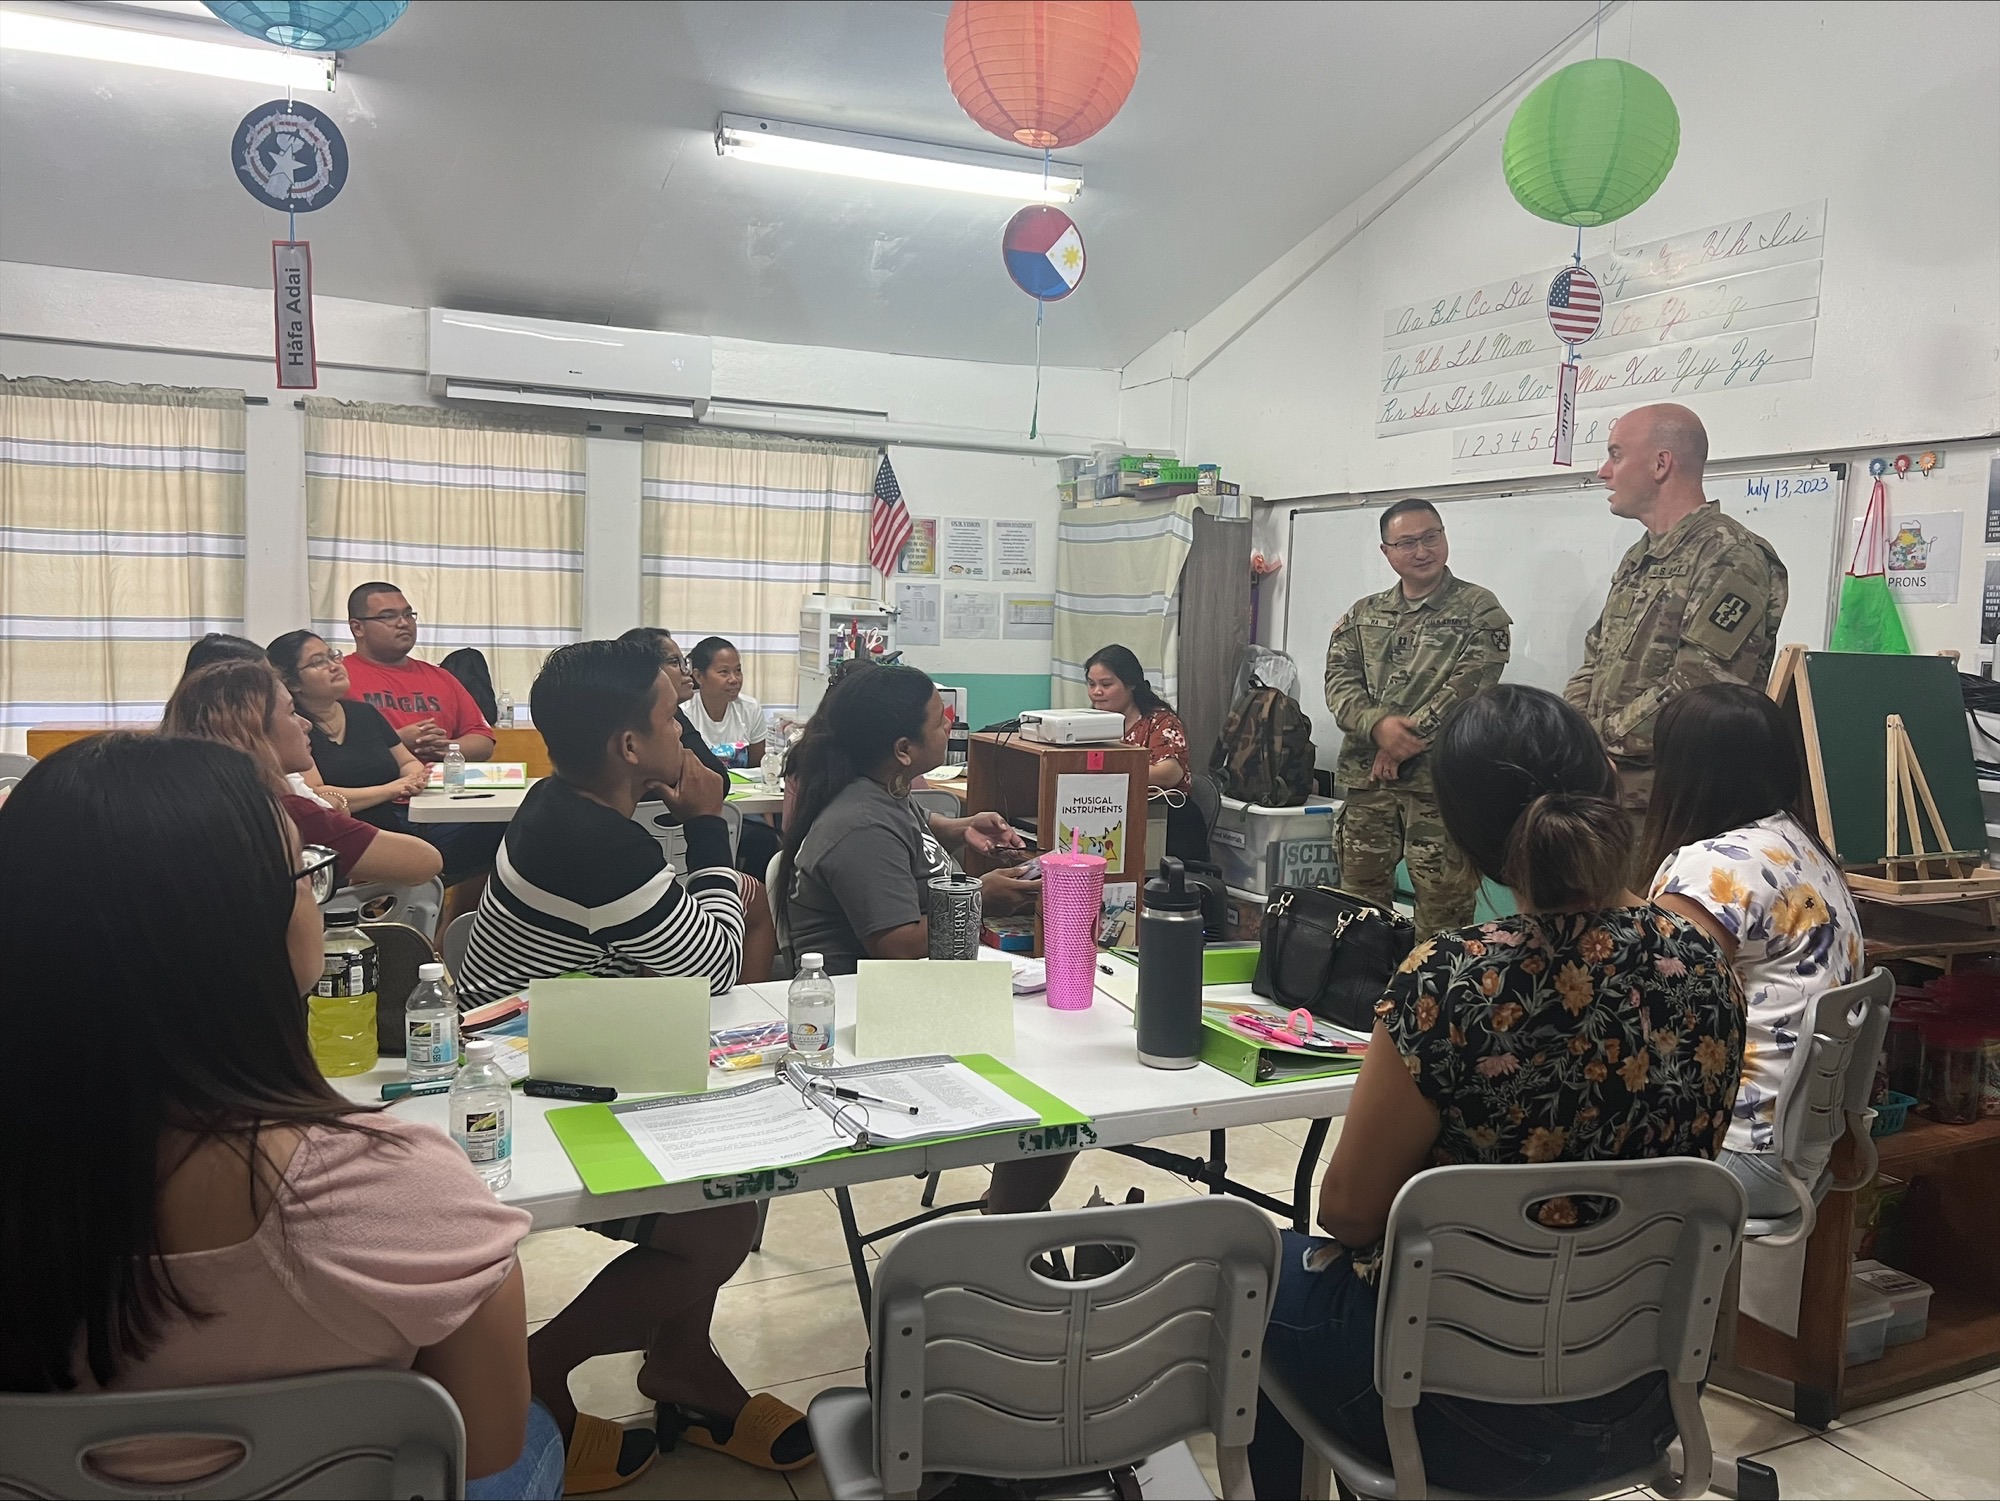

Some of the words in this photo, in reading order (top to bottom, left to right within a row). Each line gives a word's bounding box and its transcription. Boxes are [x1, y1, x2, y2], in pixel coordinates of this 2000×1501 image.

[285, 267, 302, 314] Adai
[1396, 307, 1423, 335] Aa
[1428, 295, 1462, 327] Bb
[1465, 290, 1490, 319] Cc
[1495, 281, 1534, 311] Dd
[287, 321, 304, 366] Håfa
[1562, 392, 1572, 441] Hello
[1471, 435, 1486, 457] 2
[1490, 433, 1504, 455] 3
[1511, 431, 1522, 453] 4
[1527, 427, 1543, 451] 5
[1585, 420, 1599, 444] 8
[1746, 476, 1770, 503] July
[1888, 576, 1927, 588] PRONS
[1062, 805, 1123, 814] INSTRUMENTS
[1073, 796, 1113, 805] MUSICAL
[954, 900, 967, 957] NABETIN
